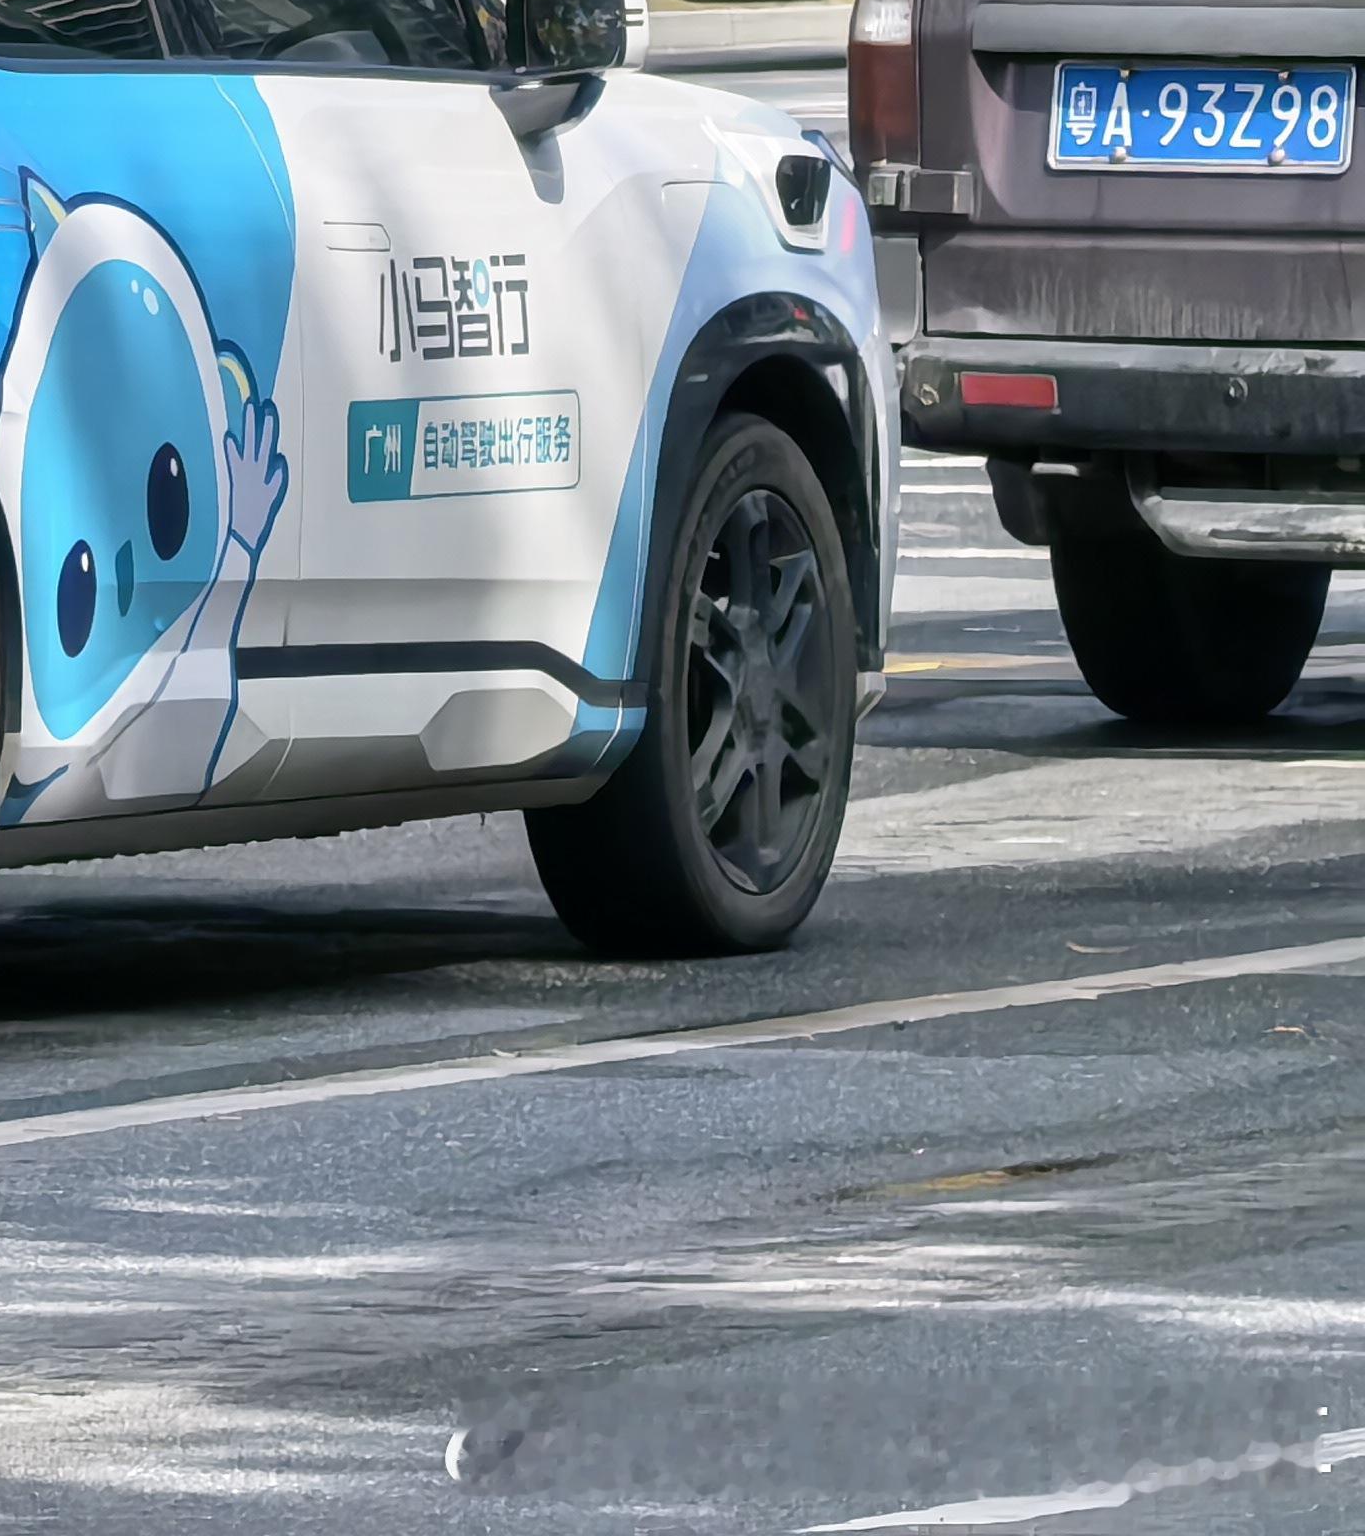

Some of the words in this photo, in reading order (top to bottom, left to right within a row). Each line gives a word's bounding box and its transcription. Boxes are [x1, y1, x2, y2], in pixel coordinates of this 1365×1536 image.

[379, 254, 529, 362] 小马智行
[364, 424, 402, 476] 广州
[423, 414, 572, 470] 自动驾驶出行服务
